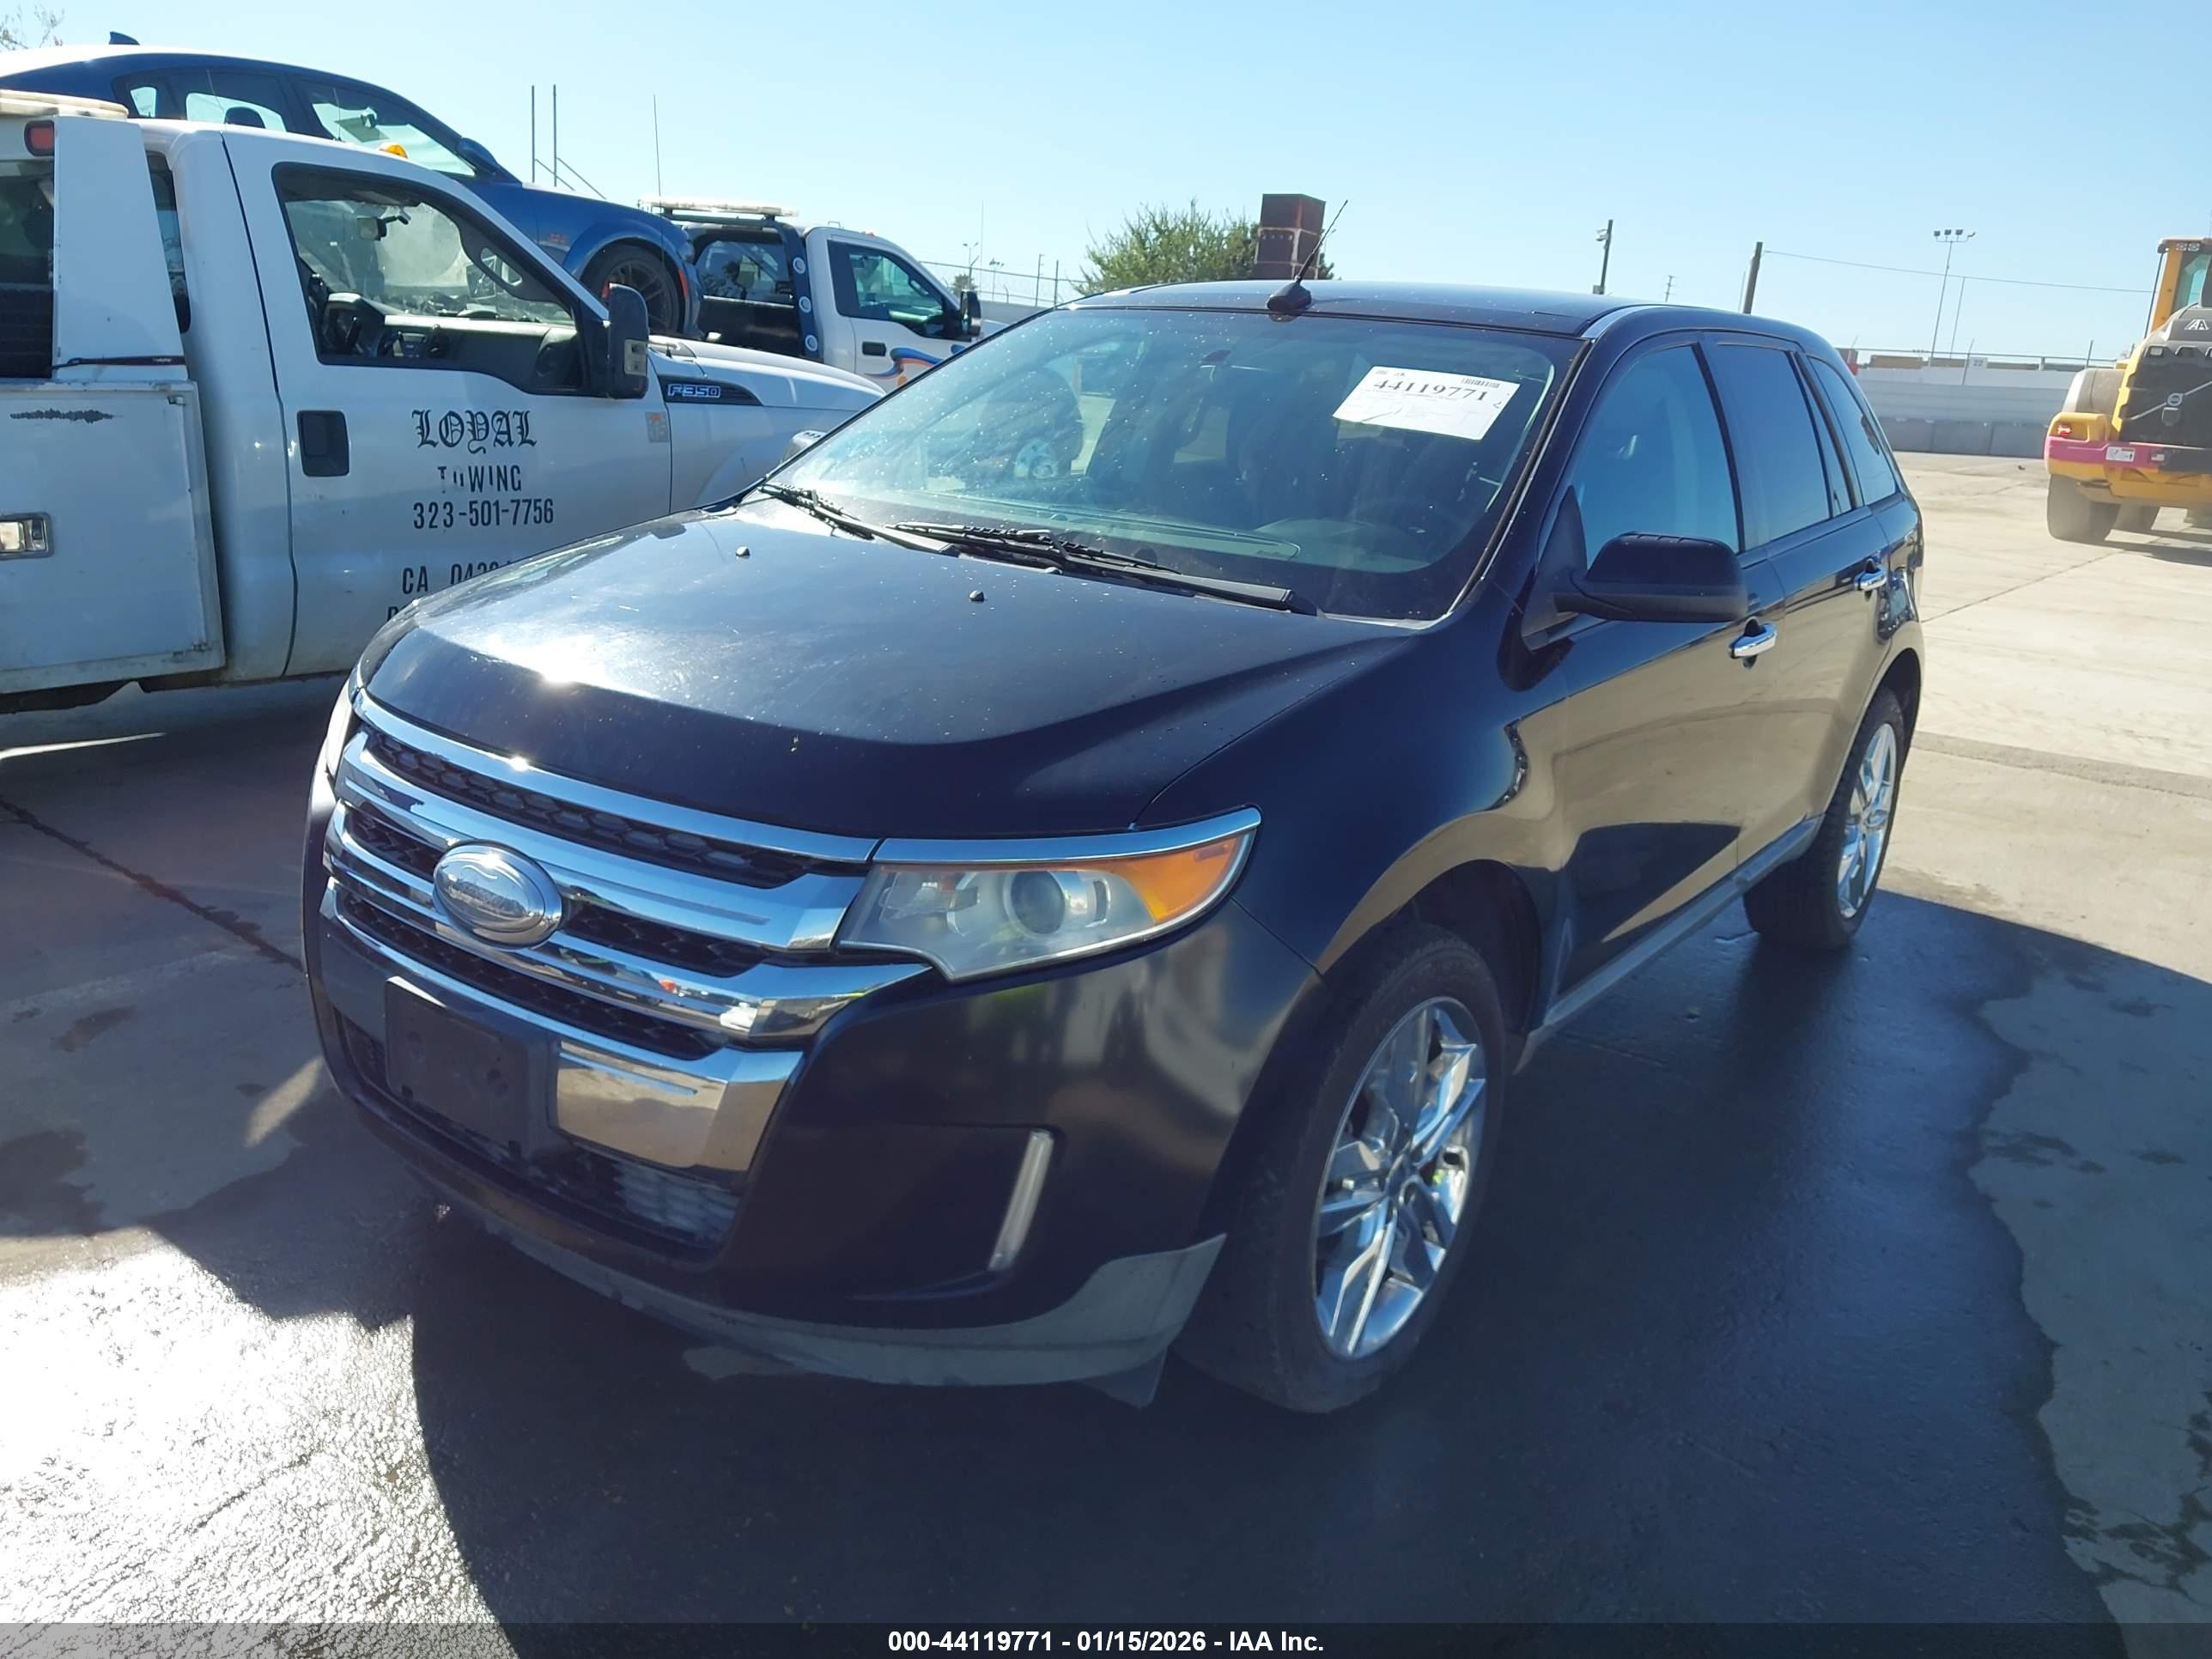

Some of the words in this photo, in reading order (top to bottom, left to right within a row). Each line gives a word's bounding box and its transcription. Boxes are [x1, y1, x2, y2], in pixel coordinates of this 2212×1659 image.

[1373, 379, 1488, 401] 44119771
[411, 409, 538, 454] LOYAL
[413, 498, 554, 529] 323-501-7756
[402, 566, 428, 594] CA
